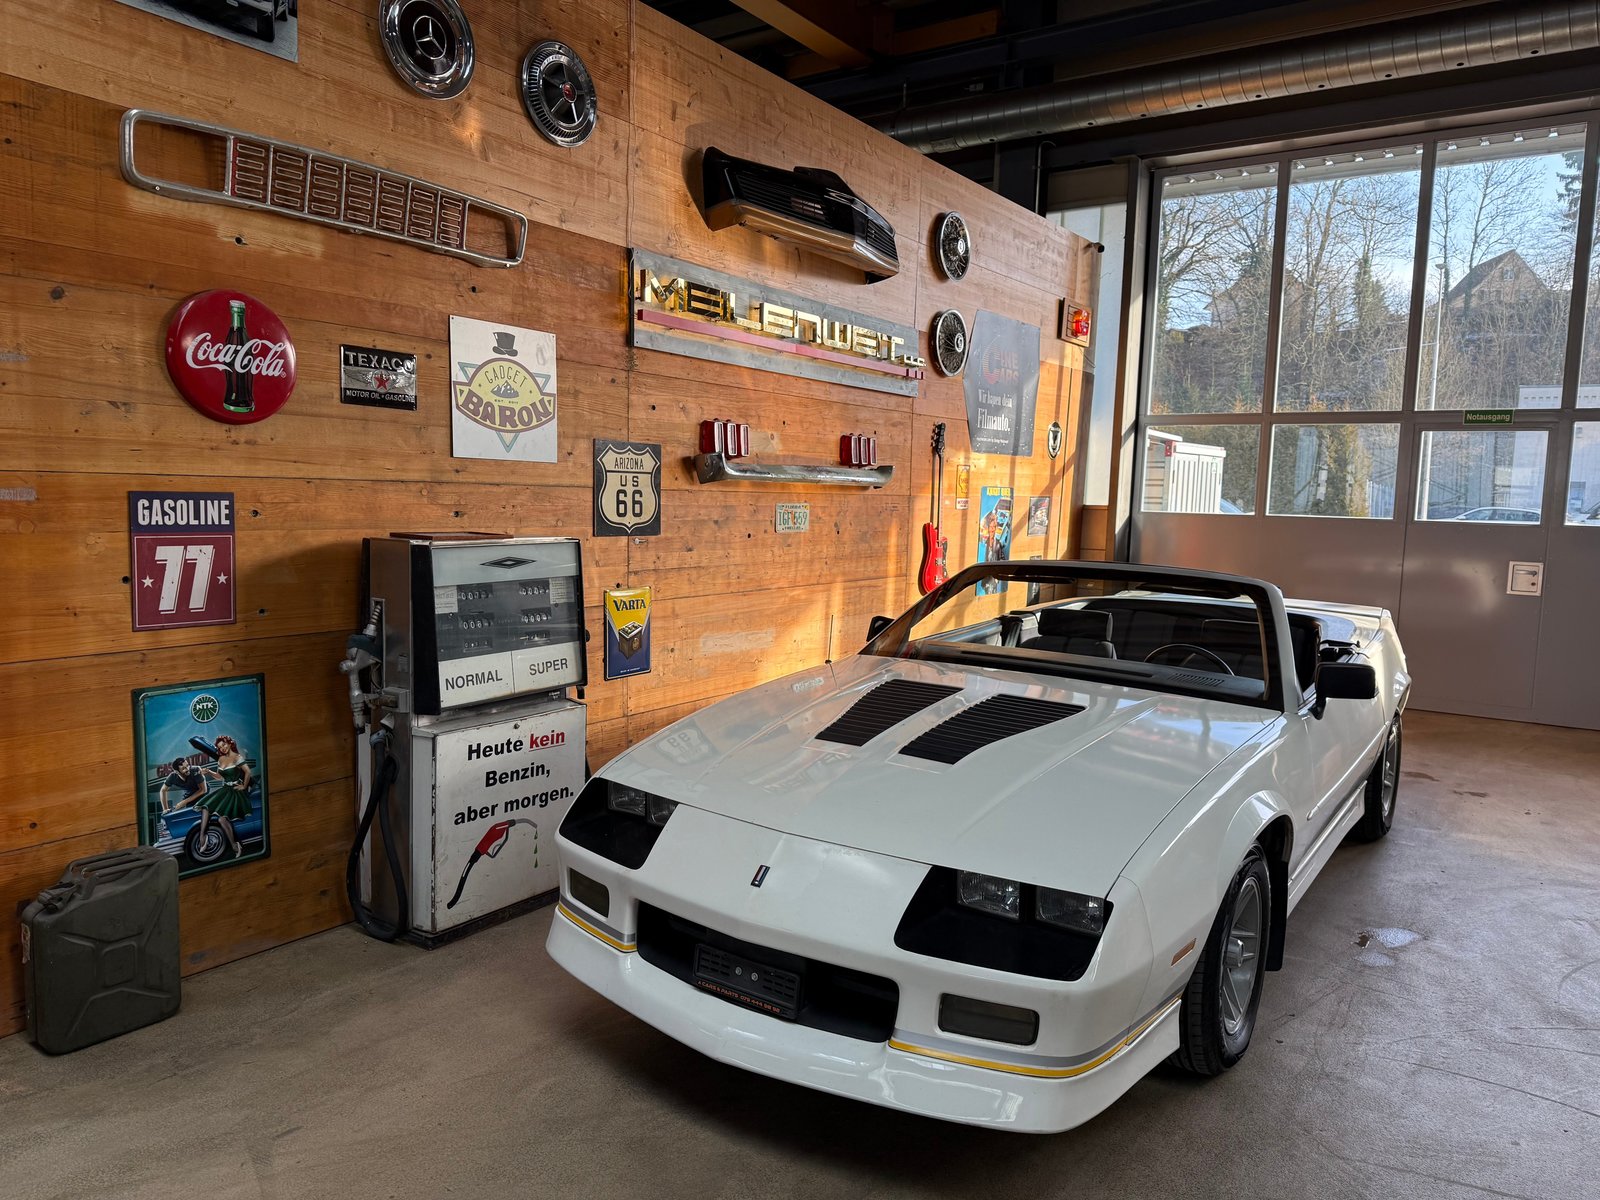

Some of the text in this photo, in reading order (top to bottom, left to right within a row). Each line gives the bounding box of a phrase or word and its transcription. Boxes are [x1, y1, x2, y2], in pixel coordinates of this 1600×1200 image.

[185, 332, 285, 378] Coca-Cola
[345, 351, 414, 372] TEXACO
[484, 365, 527, 387] GADGET
[346, 390, 370, 398] MOTOR
[385, 394, 415, 403] GASOLINE
[460, 388, 552, 428] BARON
[1466, 413, 1511, 421] Notausgang
[614, 457, 644, 470] ARIZONA
[137, 499, 230, 526] GASOLINE
[616, 489, 643, 518] 66
[155, 545, 215, 615] 77
[613, 598, 647, 612] VARTA
[529, 657, 568, 676] SUPER
[445, 669, 503, 691] NORMAL
[195, 701, 214, 711] NTK
[467, 730, 565, 761] Heute kein
[485, 762, 550, 788] Benzin,
[454, 786, 574, 825] aber morgen.
